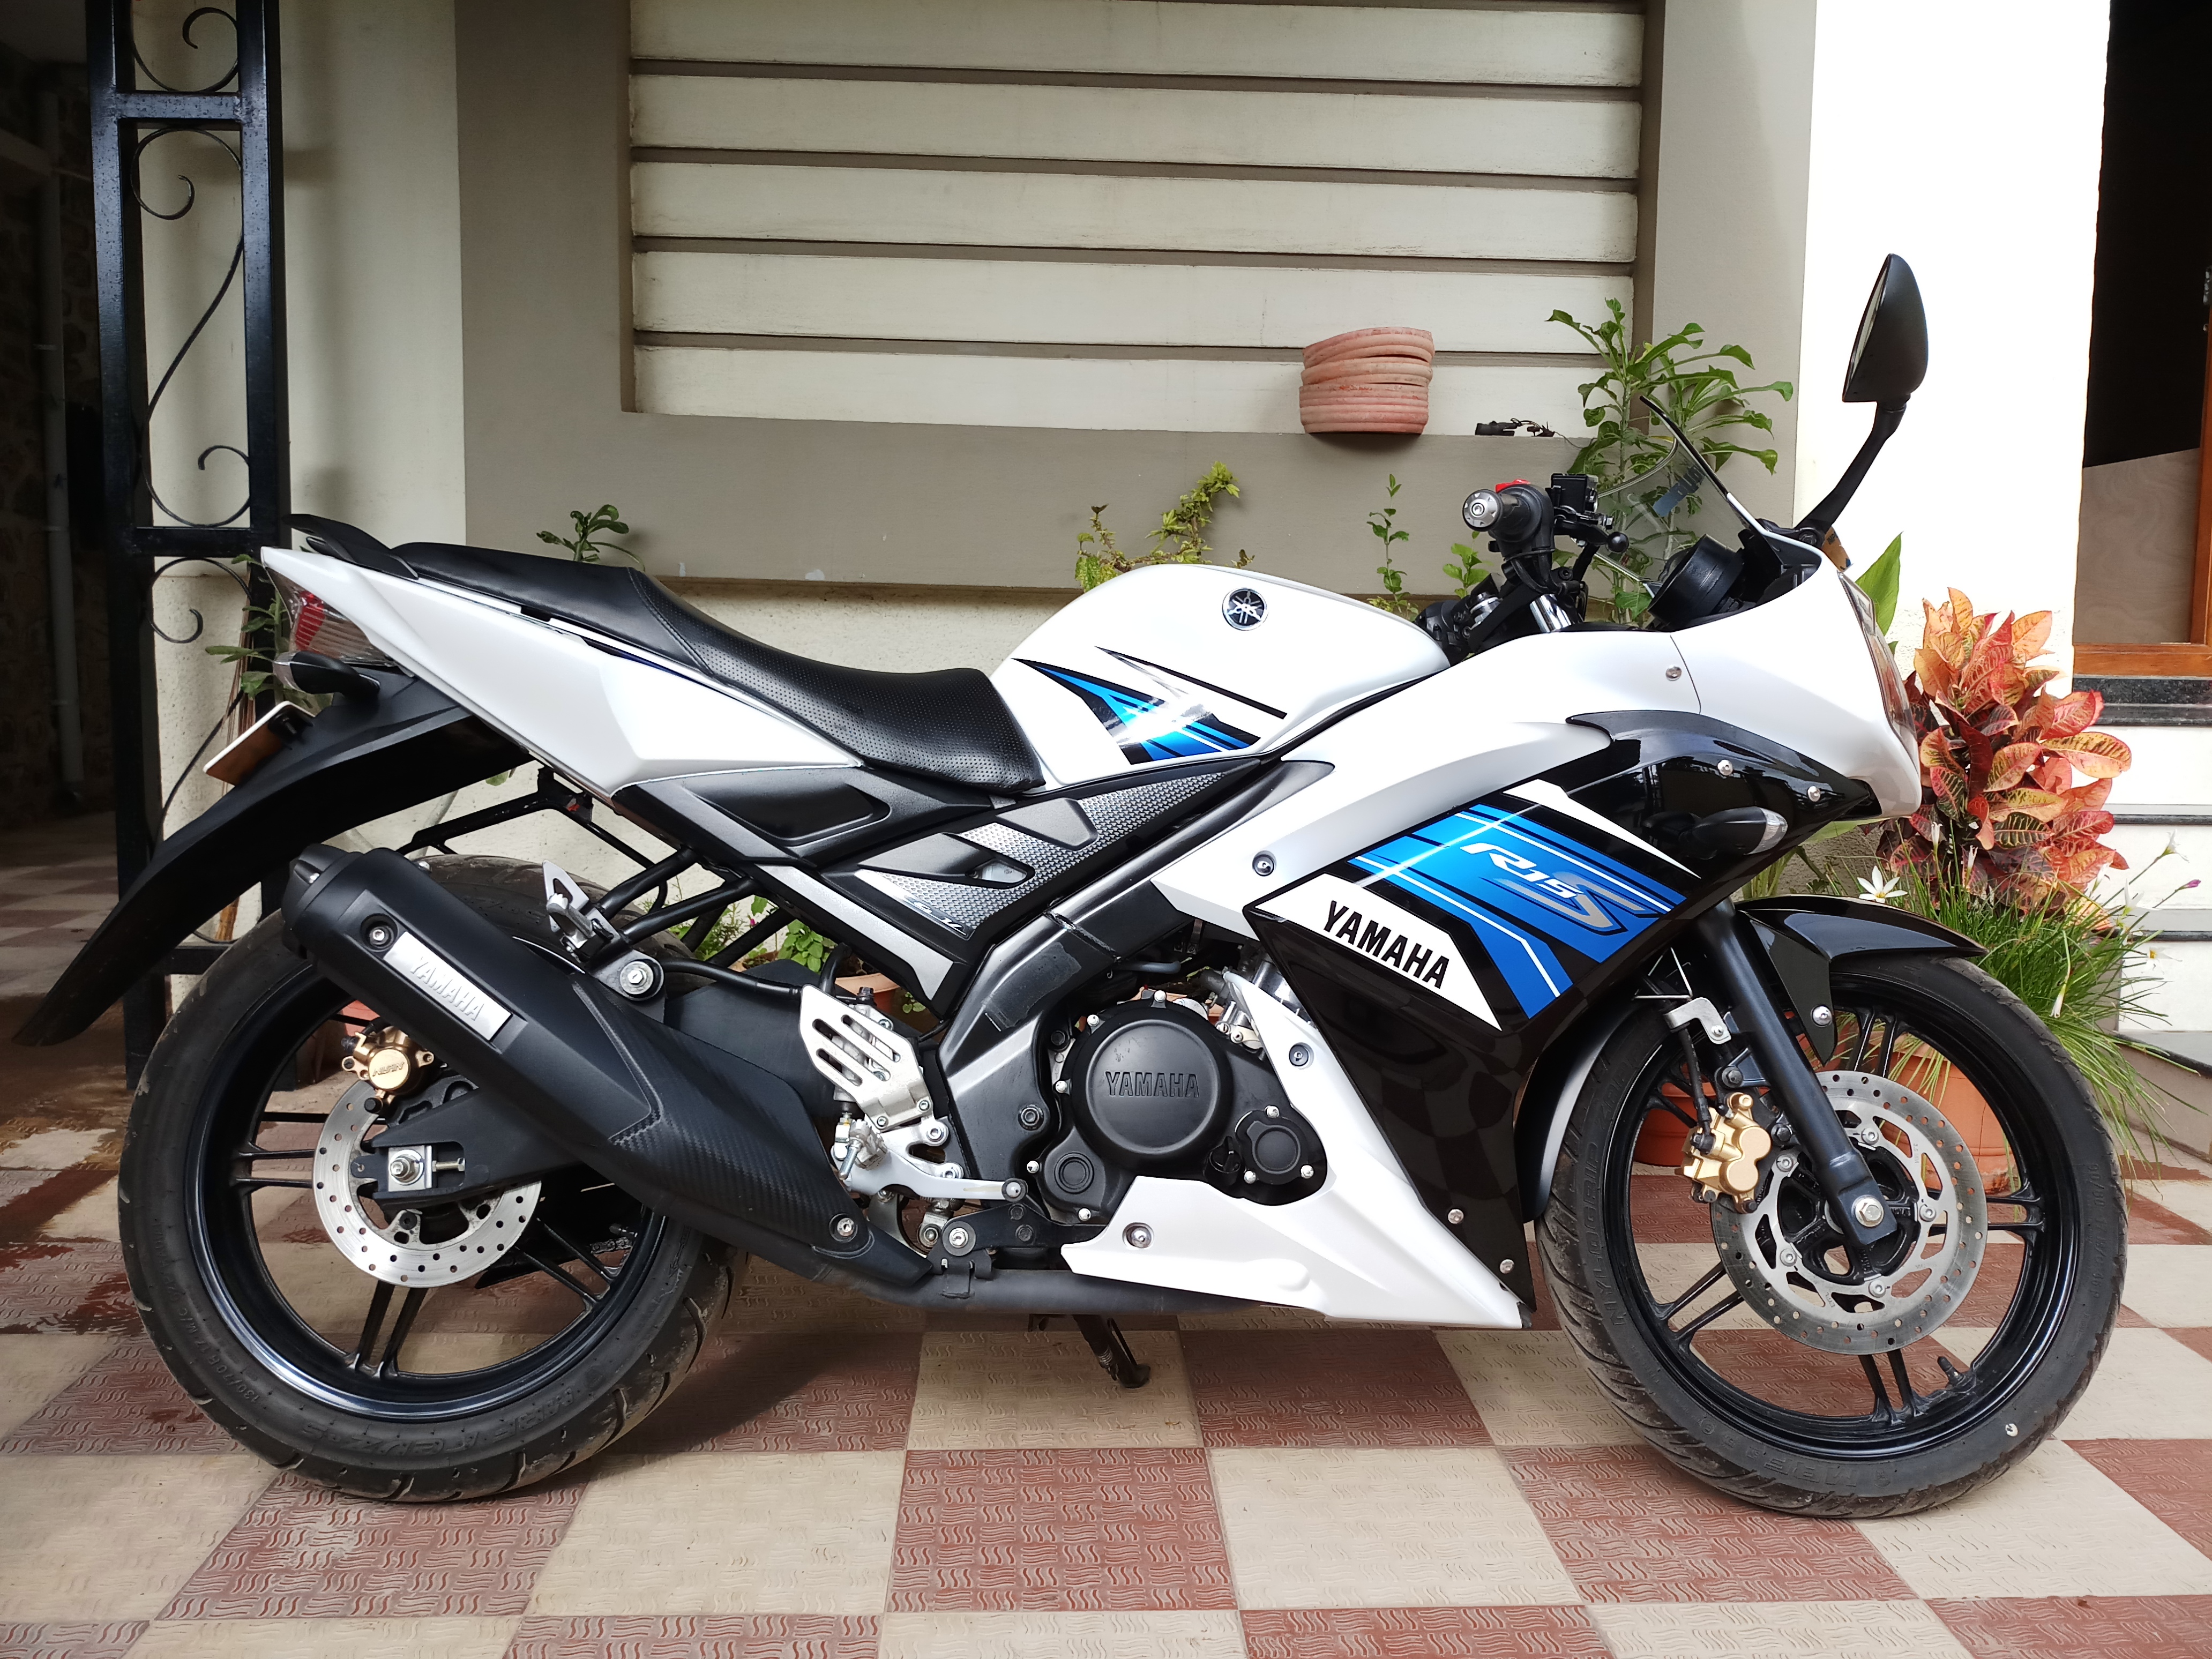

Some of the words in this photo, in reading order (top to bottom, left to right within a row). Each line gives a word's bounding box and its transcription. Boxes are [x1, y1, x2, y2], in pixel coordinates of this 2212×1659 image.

[1323, 900, 1449, 989] YAMAHA
[409, 955, 485, 1021] YAMAHA
[1105, 1071, 1200, 1098] YAMAHA
[1582, 1142, 1626, 1326] NYLOGRIP
[177, 1307, 199, 1335] M/C
[208, 1355, 261, 1405] 130/70R
[493, 1389, 576, 1441] MRF
